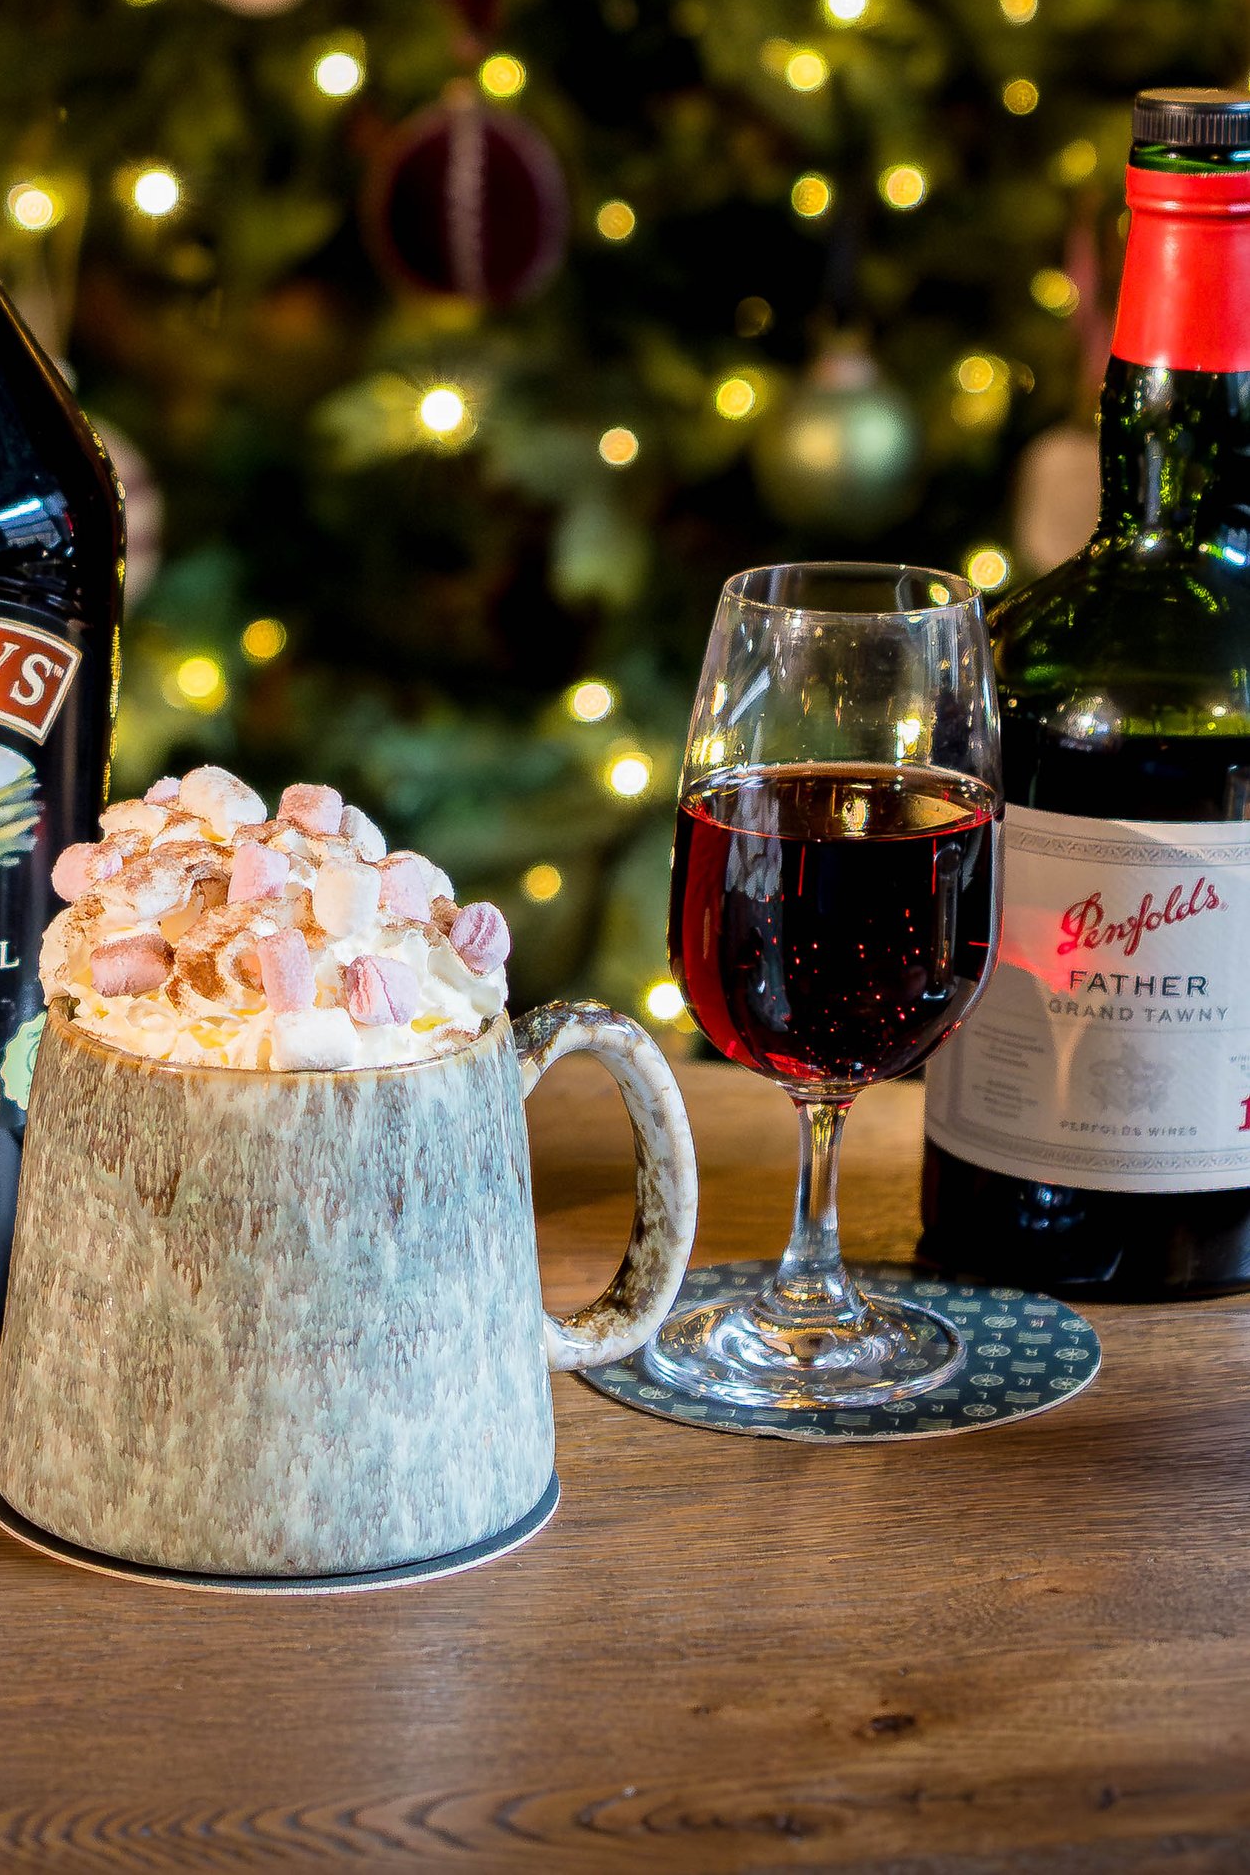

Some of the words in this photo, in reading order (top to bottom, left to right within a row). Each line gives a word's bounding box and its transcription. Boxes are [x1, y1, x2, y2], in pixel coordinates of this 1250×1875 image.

[1056, 876, 1220, 957] Penfolds
[1070, 970, 1209, 997] FATHER
[1048, 997, 1135, 1022] GRAND
[1144, 1006, 1229, 1023] TAWNY
